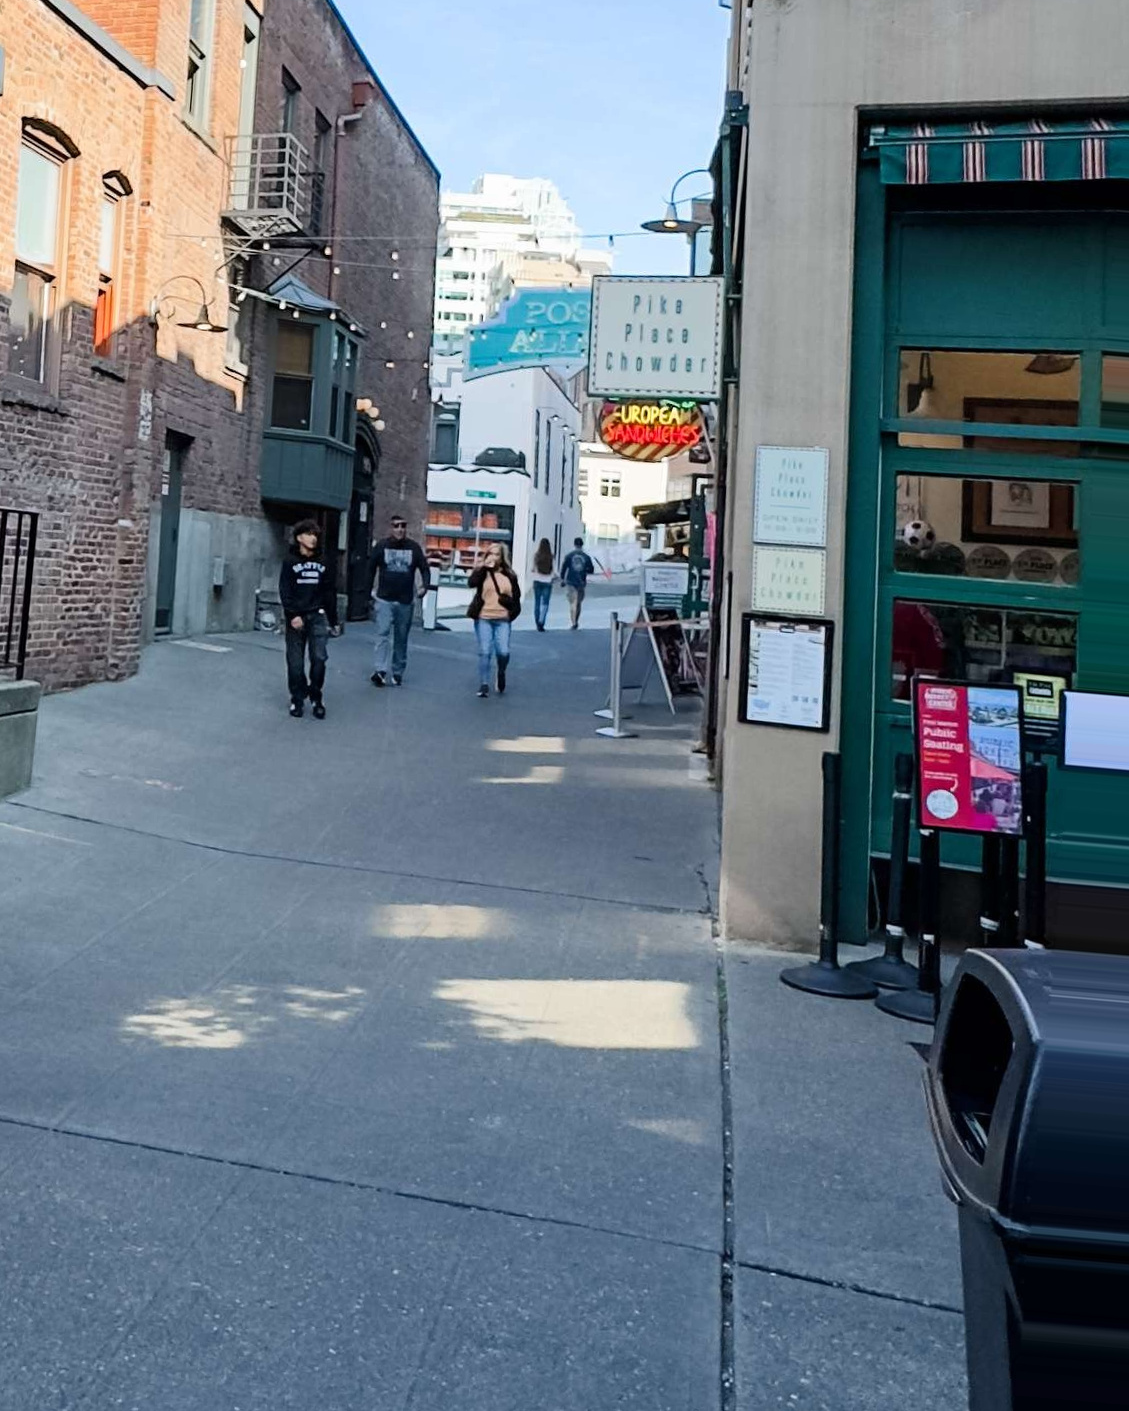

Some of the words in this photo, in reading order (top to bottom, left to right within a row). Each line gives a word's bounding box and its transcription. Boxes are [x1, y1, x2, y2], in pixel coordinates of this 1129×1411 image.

[525, 301, 590, 325] POS
[633, 295, 683, 314] Pike
[508, 328, 589, 353] ALL
[625, 324, 689, 343] Place
[606, 352, 706, 373] Chowder
[613, 405, 686, 424] UROPEA
[607, 424, 701, 445] SANDWICHES
[923, 727, 957, 738] Public
[923, 739, 964, 753] Seating
